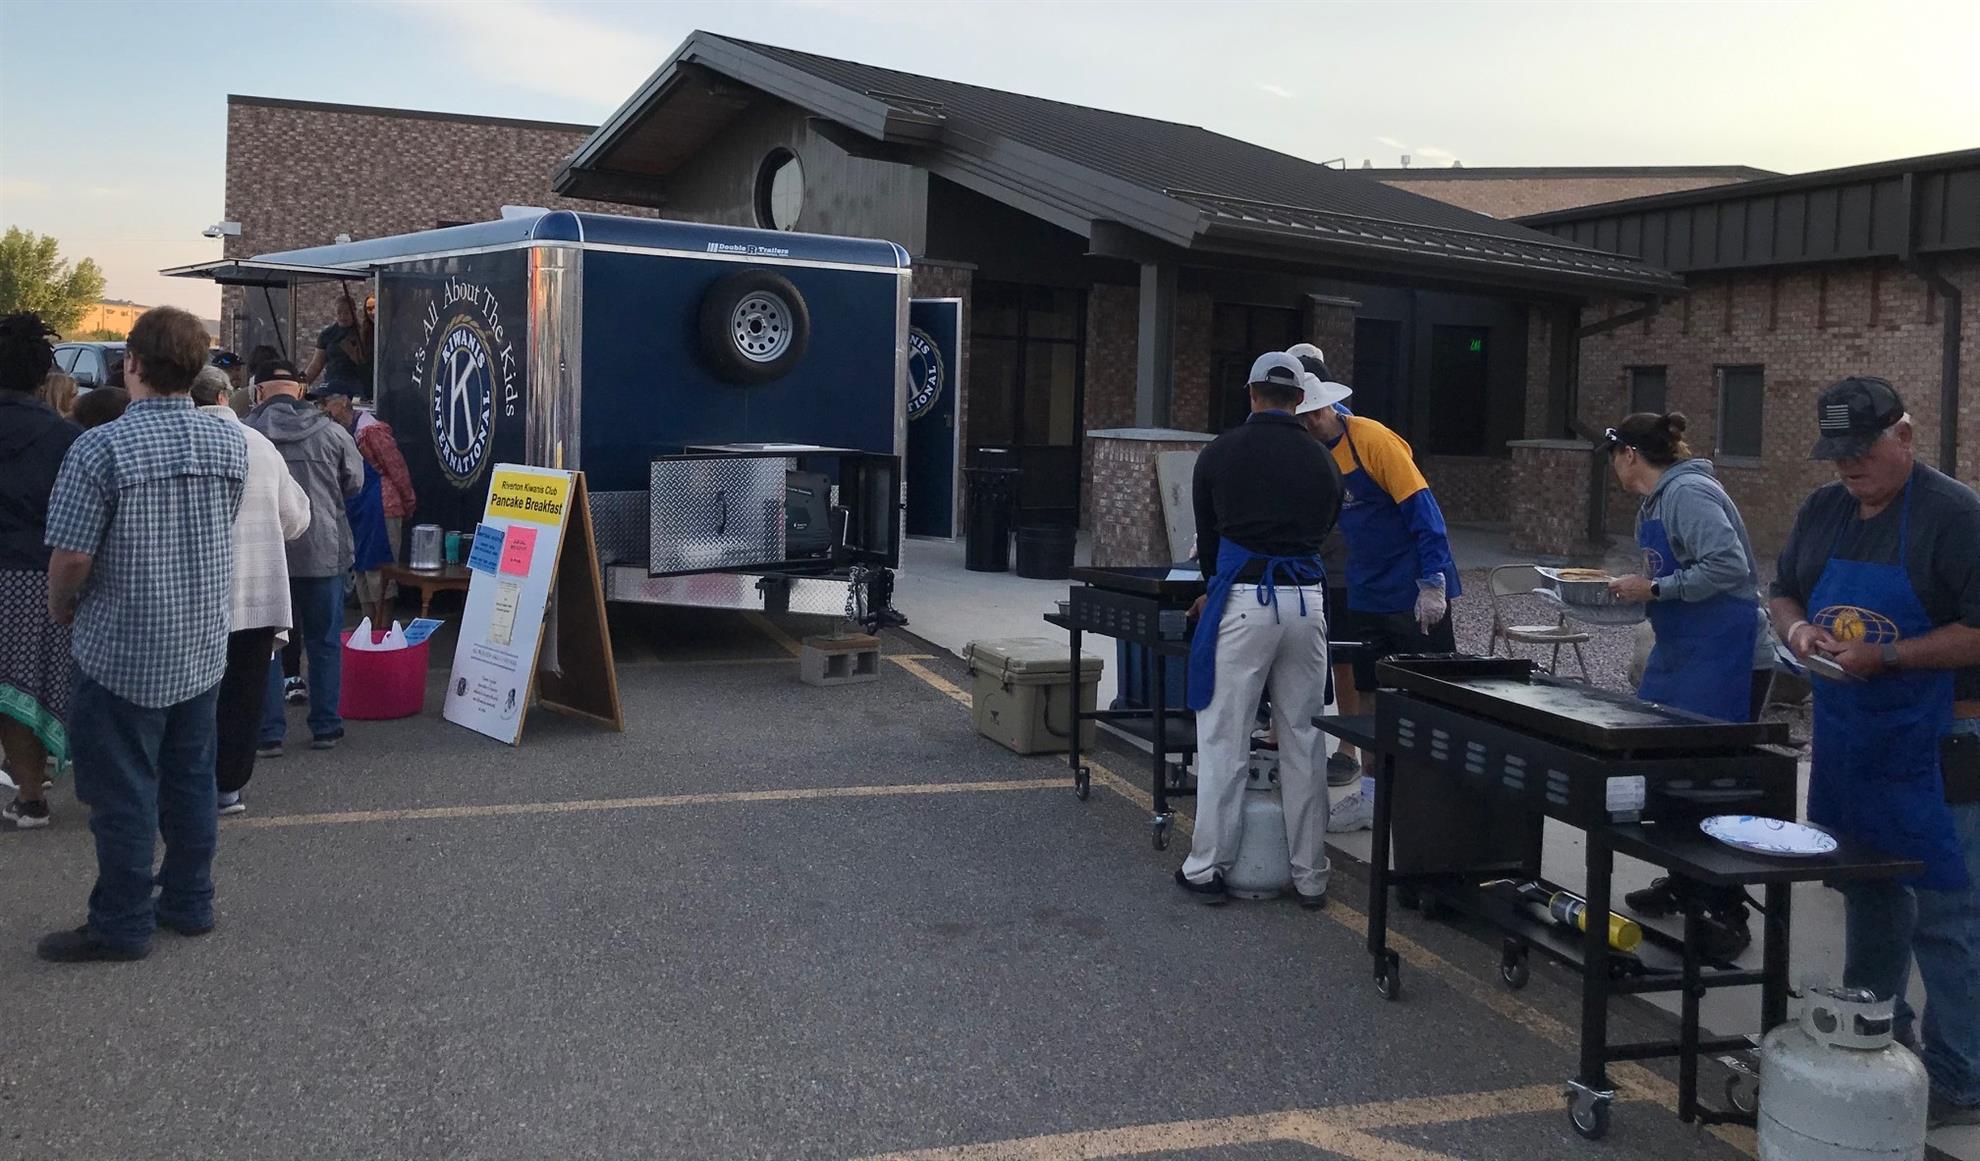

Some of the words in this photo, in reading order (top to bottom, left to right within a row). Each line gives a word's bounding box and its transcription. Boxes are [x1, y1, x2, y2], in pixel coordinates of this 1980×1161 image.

[719, 243, 746, 252] Double
[411, 347, 427, 389] It's
[423, 300, 439, 345] All
[443, 275, 480, 309] About
[482, 286, 504, 344] The
[500, 341, 518, 417] Kids
[442, 329, 486, 369] KIWANIS
[448, 350, 478, 451] K
[434, 383, 490, 474] INTERNATIONAL
[491, 493, 524, 509] Pancake
[525, 497, 563, 515] Breakfast
[502, 481, 524, 491] Riverton
[524, 483, 544, 494] Kiwanis
[545, 486, 558, 496] Club
